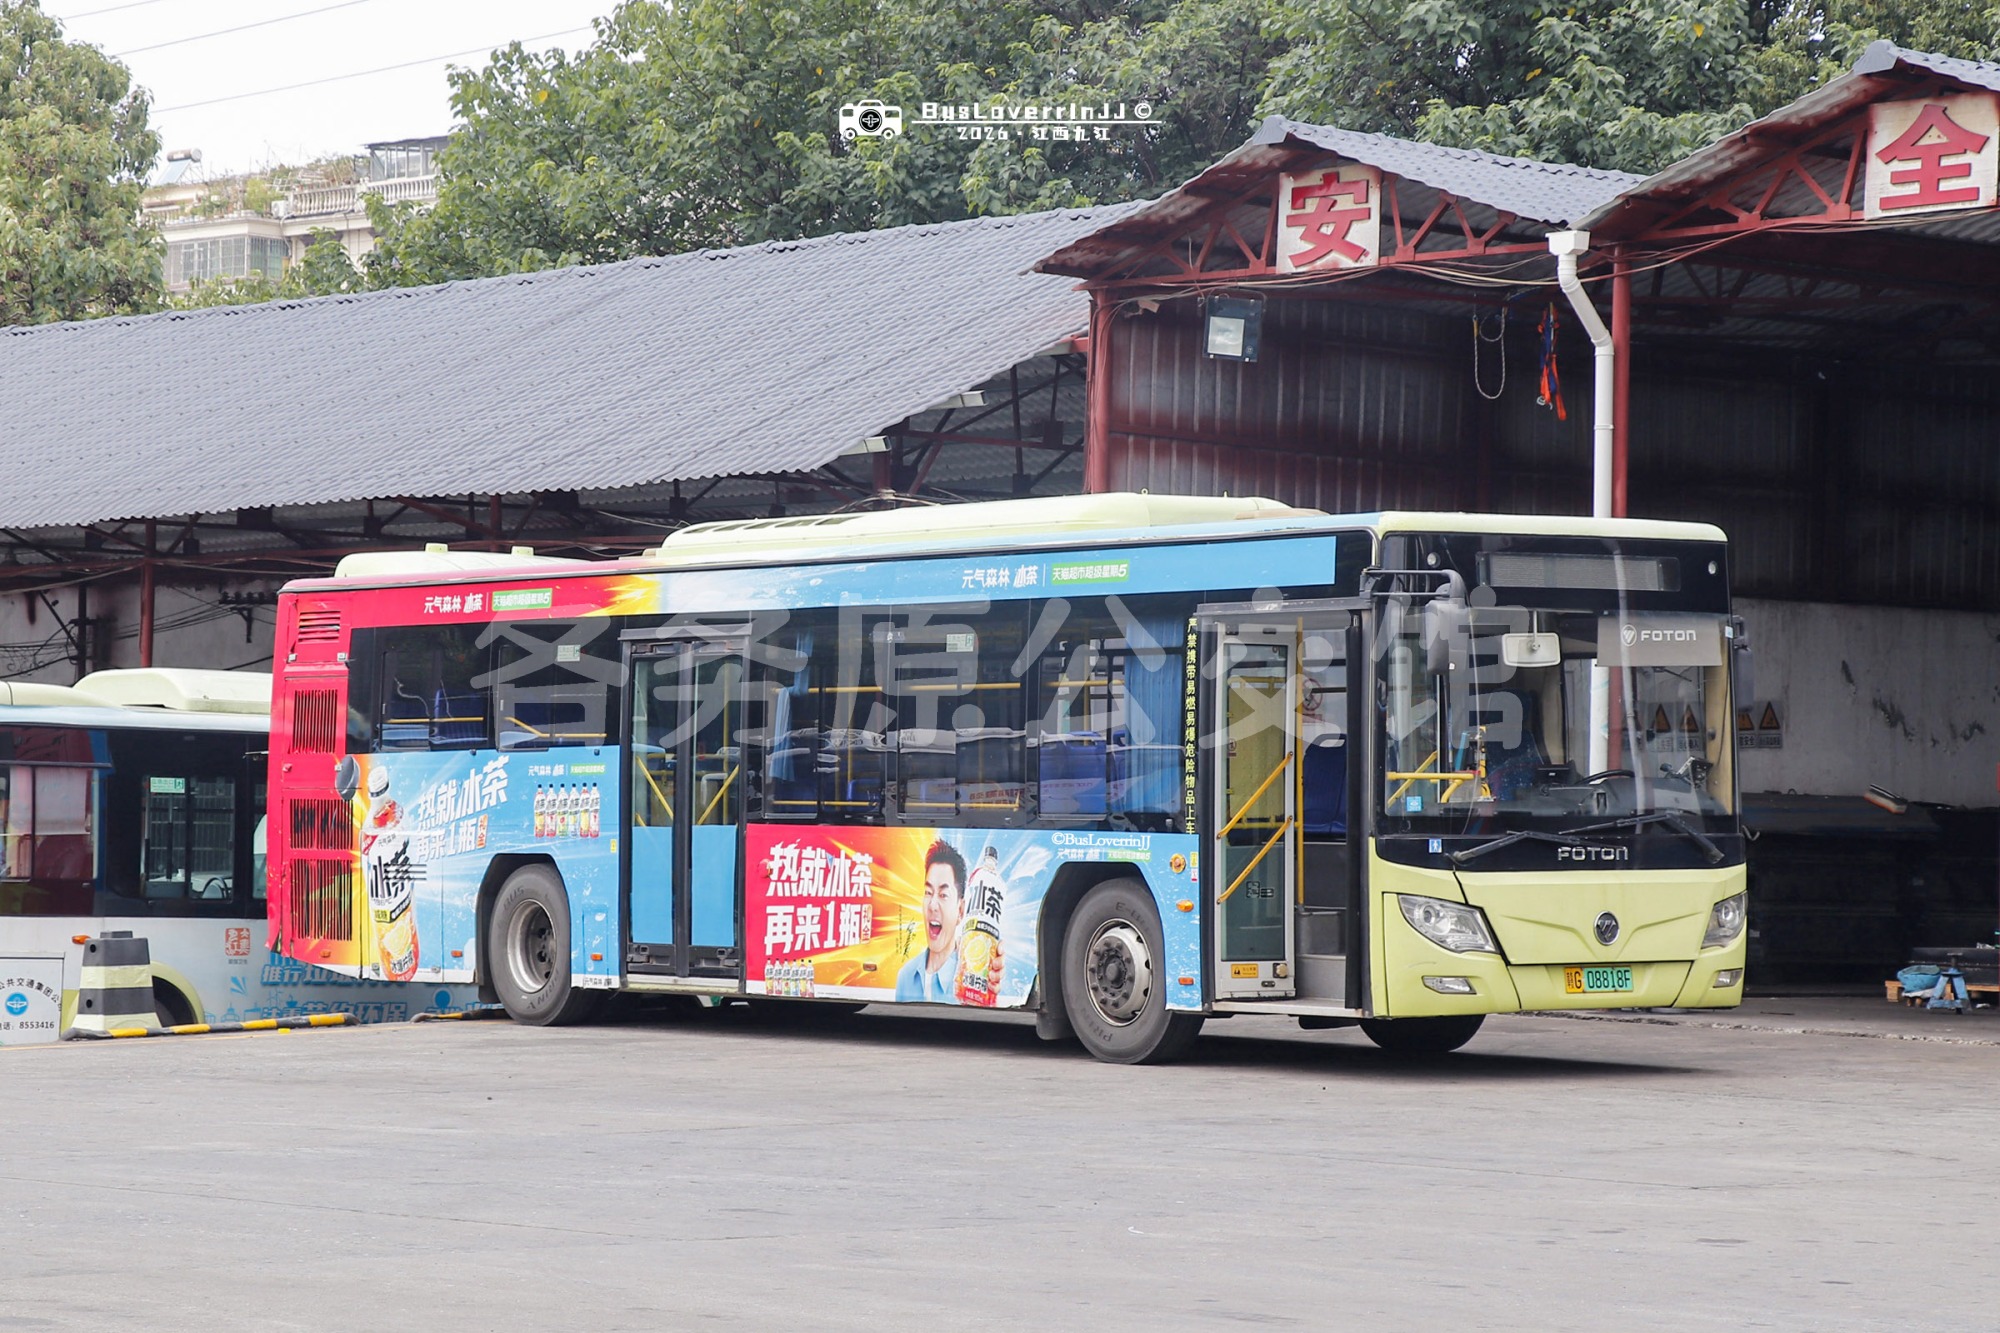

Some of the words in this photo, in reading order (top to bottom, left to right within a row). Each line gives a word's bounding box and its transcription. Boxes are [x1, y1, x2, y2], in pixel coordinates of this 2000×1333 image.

[1875, 104, 1990, 210] 全
[1286, 171, 1373, 269] 安
[962, 567, 1010, 588] 元气森林
[424, 594, 462, 613] 元气森林
[1641, 629, 1697, 641] FOTON
[1557, 846, 1629, 861] FOTON
[765, 838, 874, 897] 热就冰茶
[764, 900, 862, 956] 再来1瓶
[19, 1020, 55, 1030] 8553416
